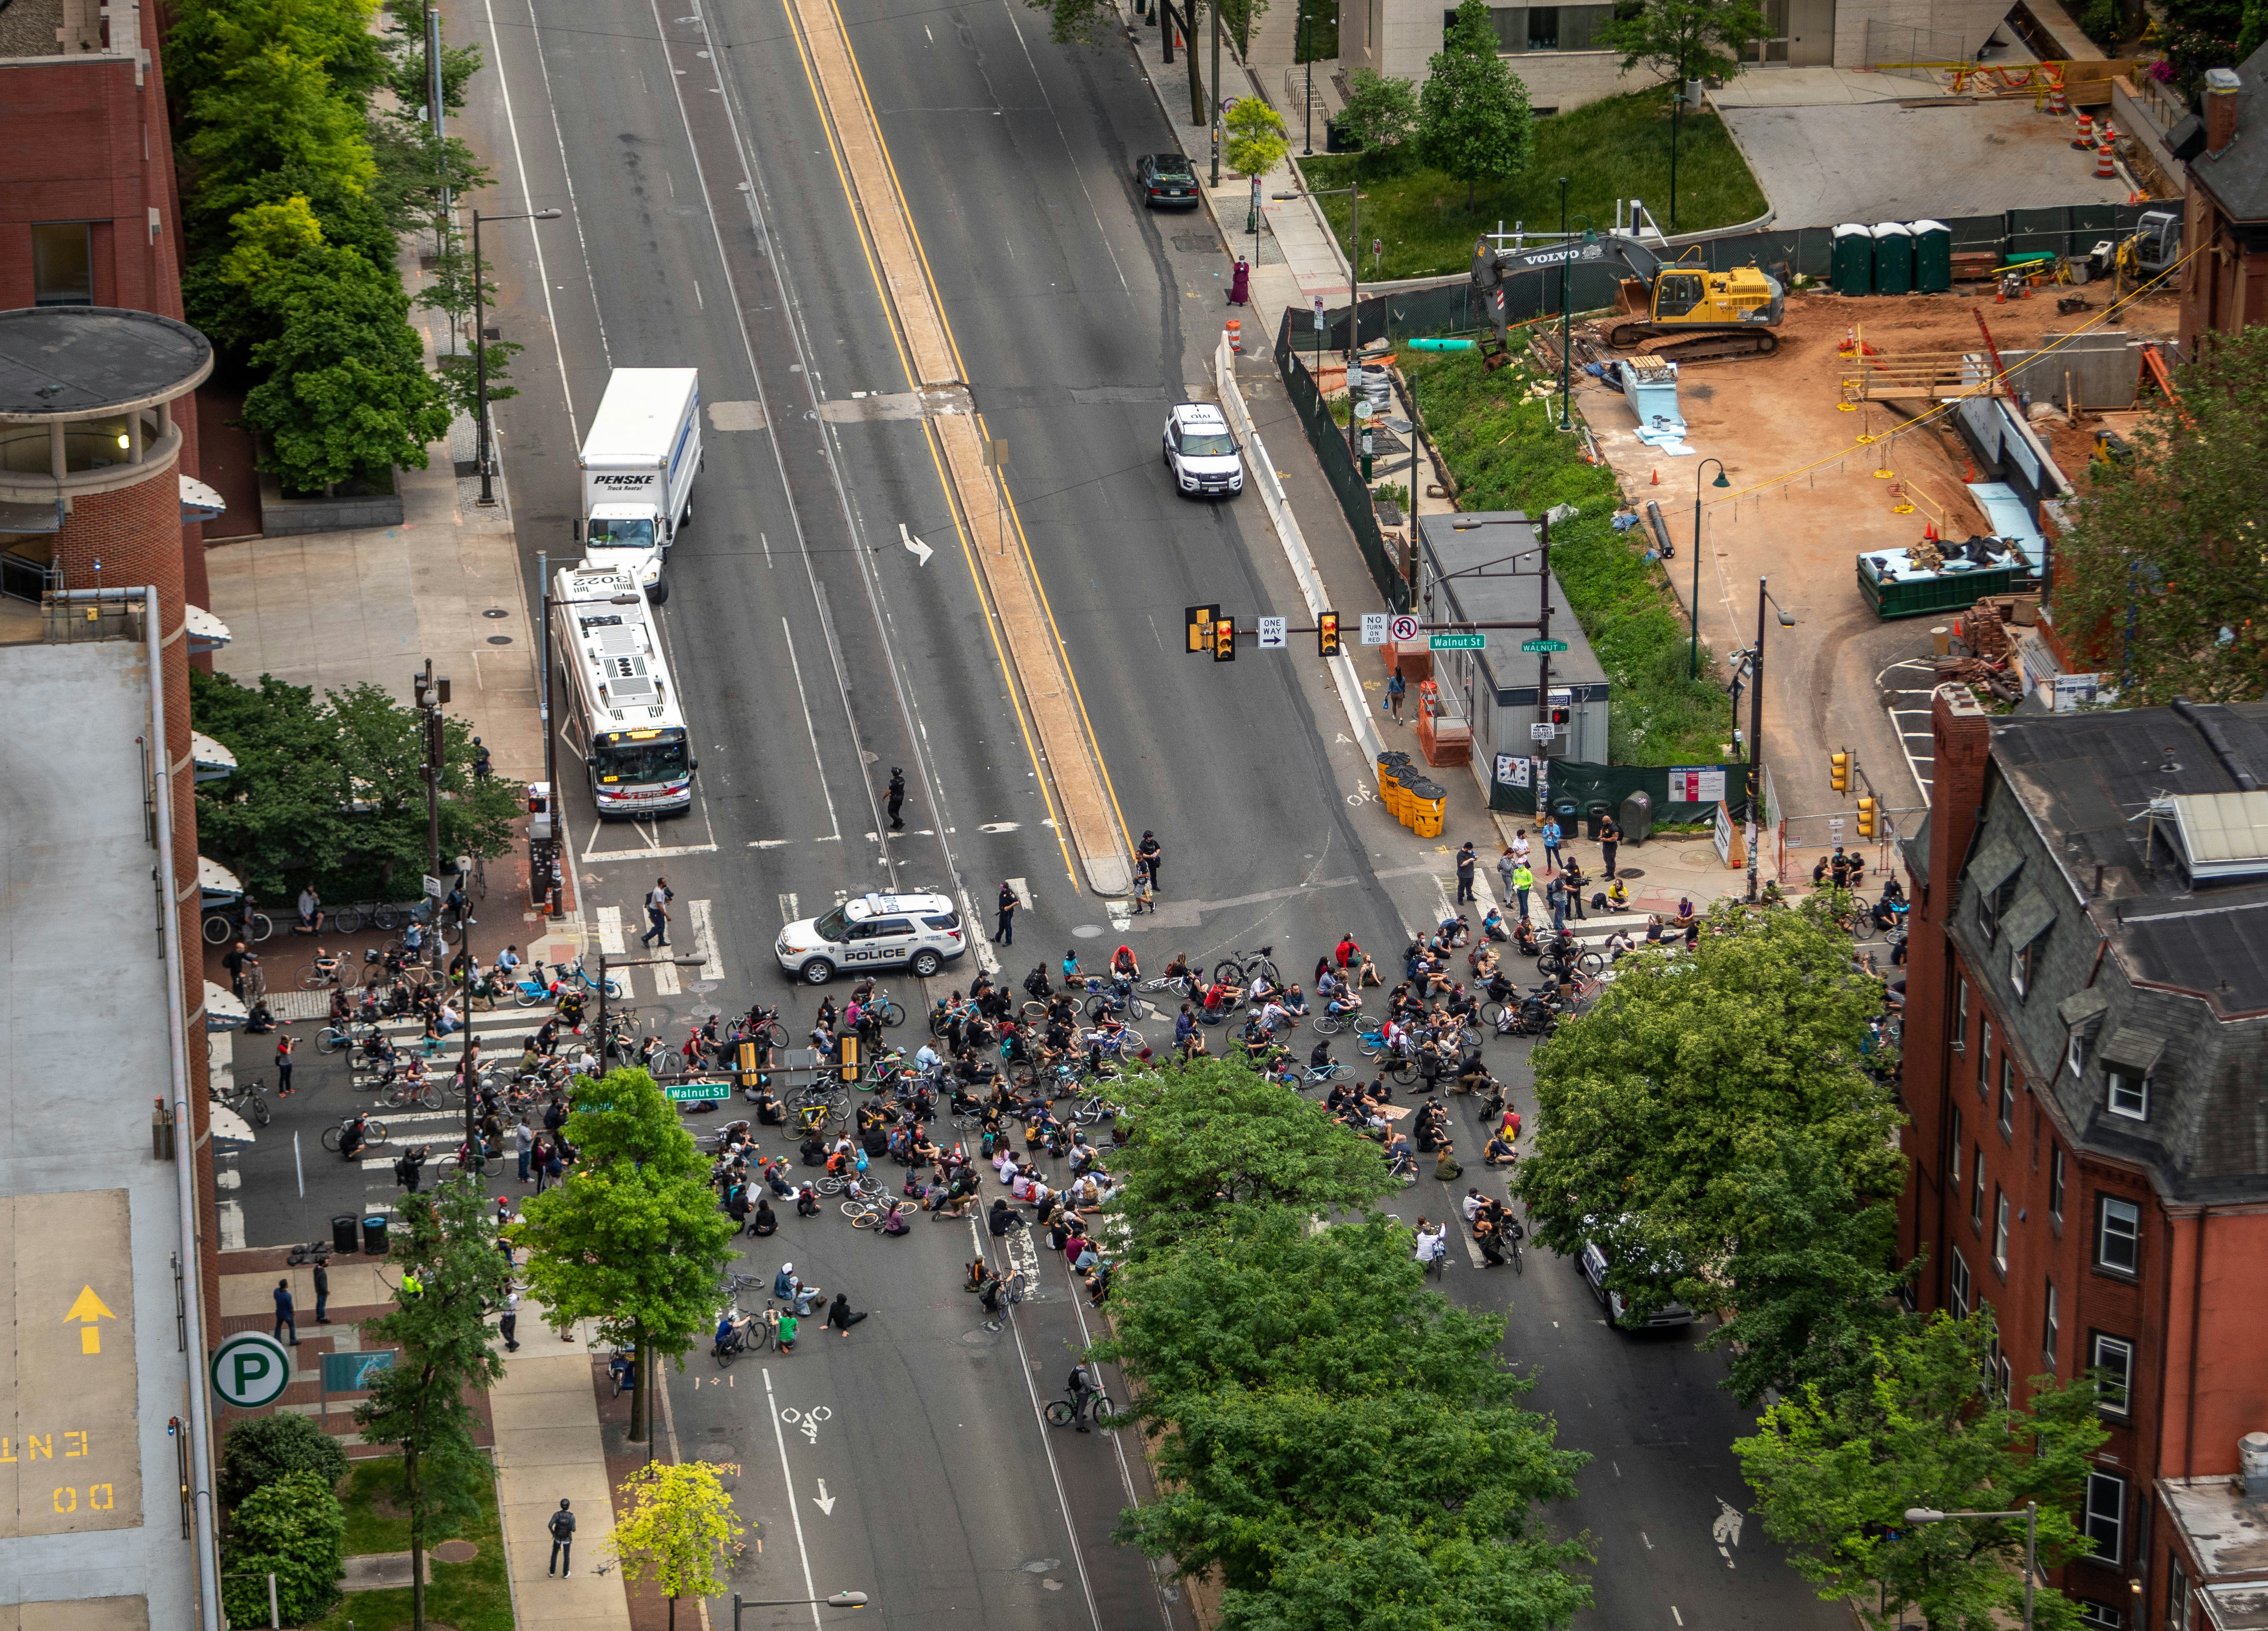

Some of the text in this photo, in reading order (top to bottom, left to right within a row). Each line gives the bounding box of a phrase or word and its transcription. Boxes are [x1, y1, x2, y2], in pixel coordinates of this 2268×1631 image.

[1524, 250, 1579, 264] VOLVO
[593, 475, 655, 484] PENSKE
[572, 576, 628, 586] 3022
[1435, 637, 1480, 647] Walnut St
[884, 897, 900, 912] 20-02
[845, 948, 906, 962] POLICE
[671, 1087, 724, 1098] Walnut St
[233, 1352, 270, 1396] P
[53, 1483, 113, 1513] DO
